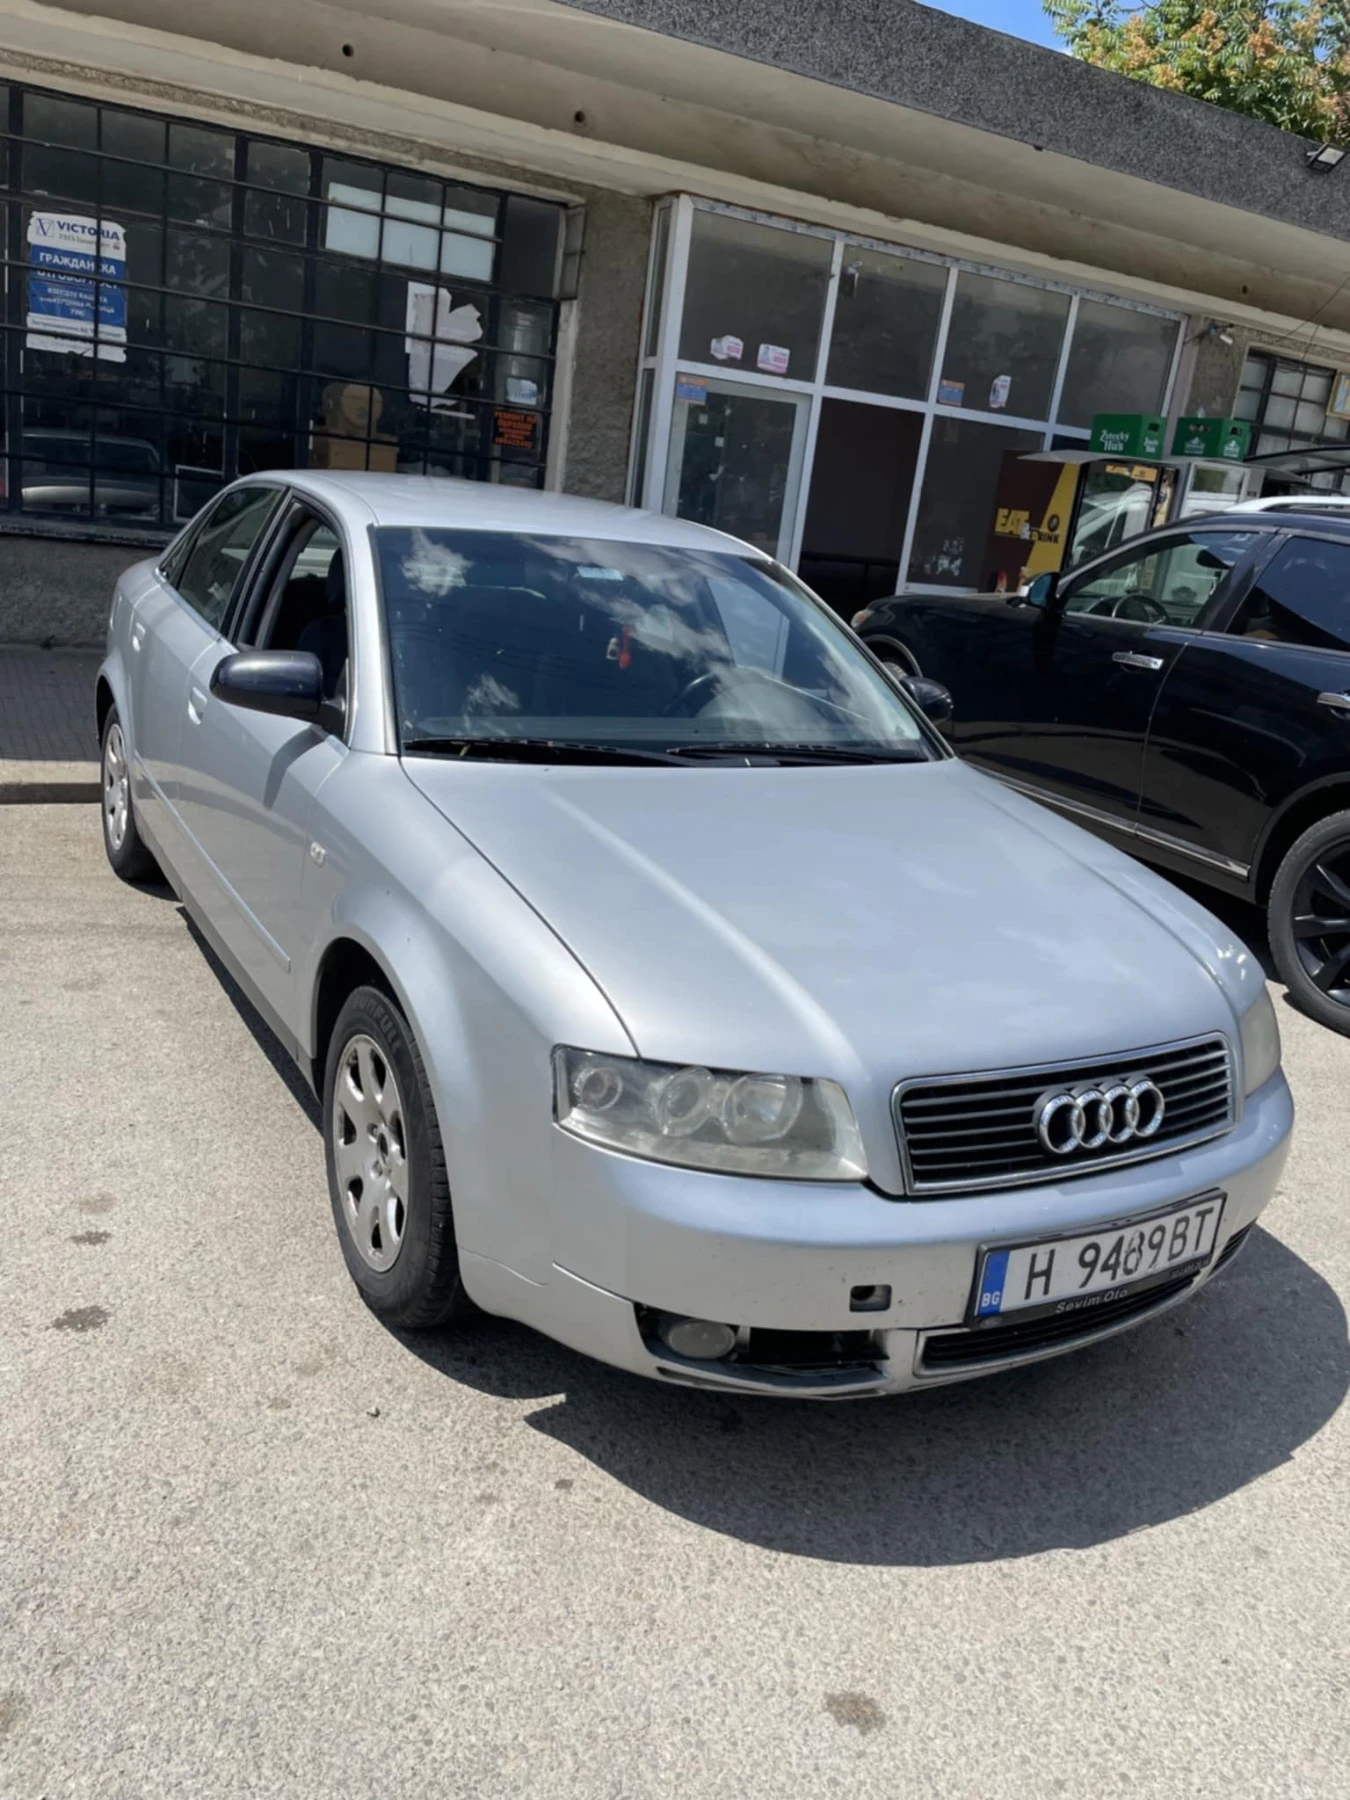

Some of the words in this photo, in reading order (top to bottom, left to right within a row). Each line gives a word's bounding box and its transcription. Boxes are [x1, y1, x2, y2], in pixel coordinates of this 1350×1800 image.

[57, 220, 120, 241] VICTORIA
[39, 252, 117, 275] ГРАЖДАНКА
[995, 508, 1030, 536] EAT
[1031, 530, 1060, 544] DRINK
[1024, 1249, 1055, 1300] H
[981, 1291, 1000, 1308] BG
[1055, 1295, 1100, 1314] Sevim
